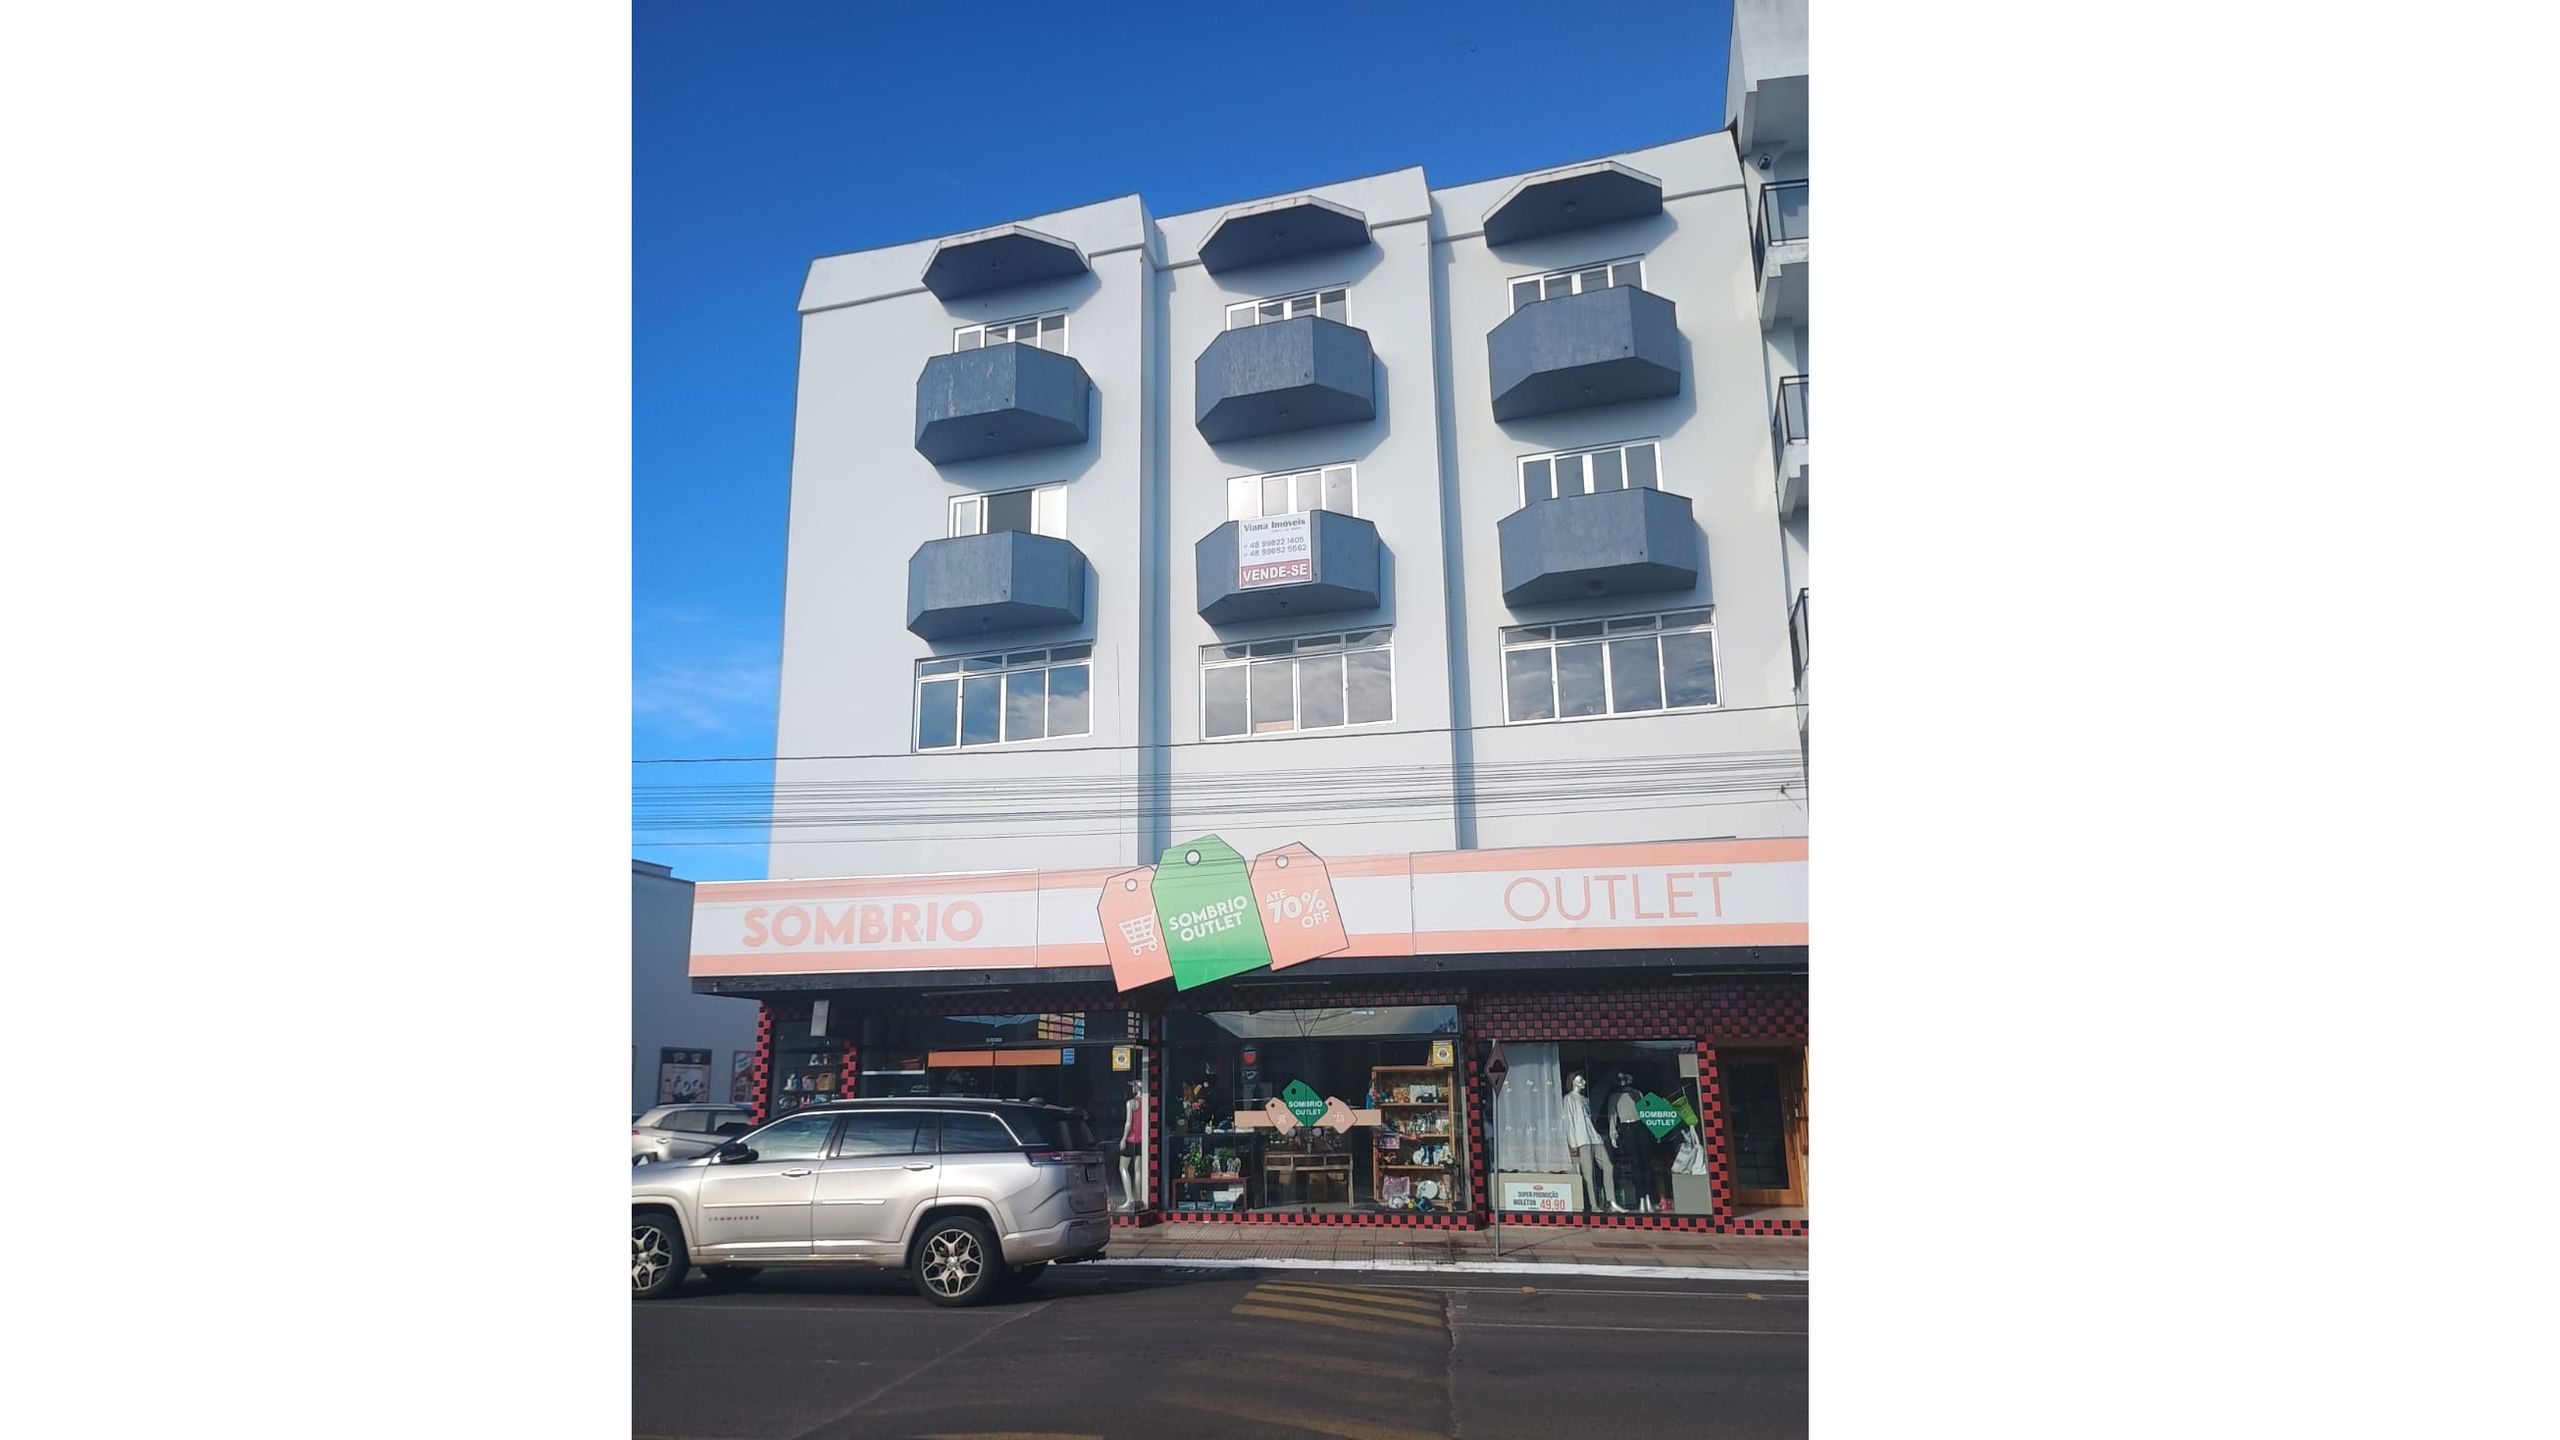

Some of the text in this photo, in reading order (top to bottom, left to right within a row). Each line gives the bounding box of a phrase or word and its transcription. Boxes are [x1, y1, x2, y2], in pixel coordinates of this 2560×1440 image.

[1243, 523, 1269, 532] Viana
[1271, 518, 1306, 528] Imóveis
[1243, 563, 1307, 582] VENDE-SE
[1503, 871, 1733, 922] OUTLET
[1168, 895, 1248, 931] SOMBRIO
[1266, 888, 1327, 925] 70%
[741, 899, 984, 948] SOMBRIO
[1180, 912, 1243, 942] OUTLET
[1301, 910, 1331, 929] OFF
[1288, 1100, 1323, 1108] SOMBRIO
[1295, 1108, 1321, 1116] OUTLET
[1639, 1110, 1677, 1118] SOMBRIO
